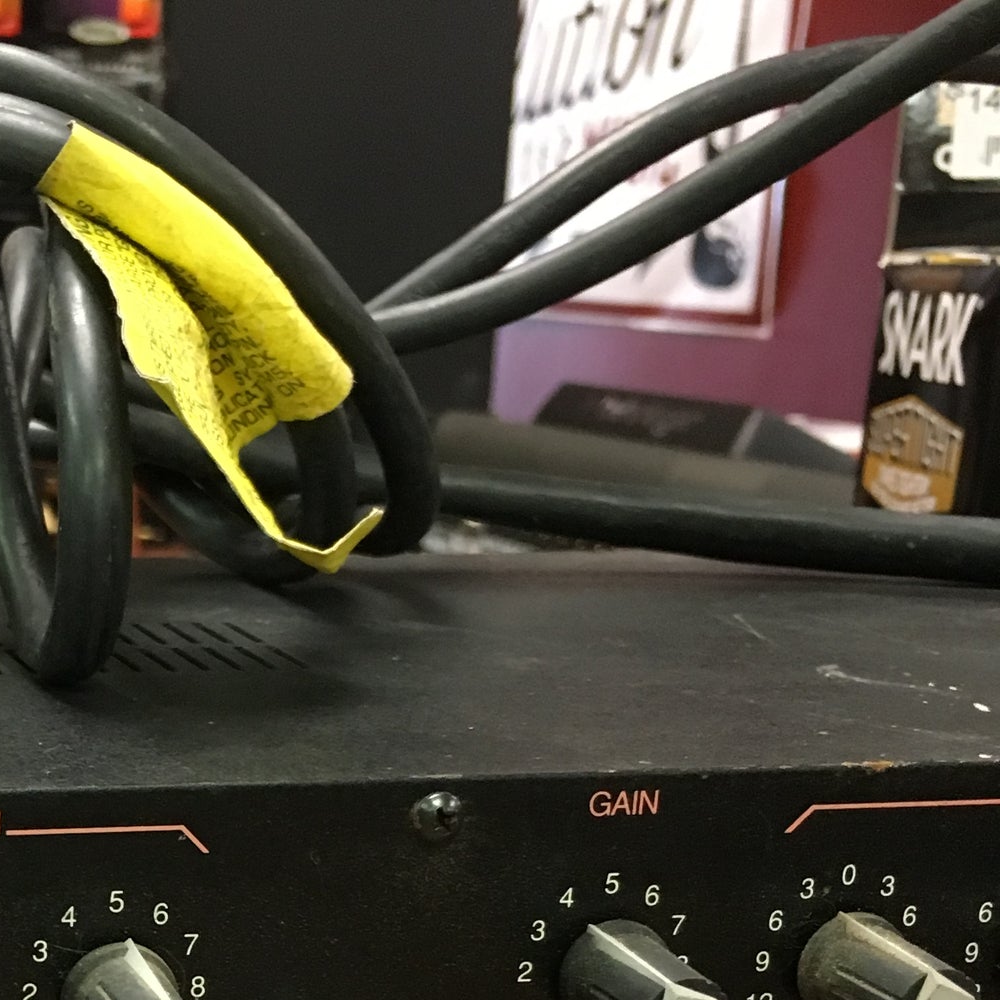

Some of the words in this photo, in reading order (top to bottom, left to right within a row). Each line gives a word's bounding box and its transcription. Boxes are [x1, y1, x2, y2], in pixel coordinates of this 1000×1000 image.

[877, 288, 980, 387] SNARK
[589, 789, 660, 817] GAIN
[604, 872, 620, 895] 5
[841, 863, 857, 886] 0
[880, 875, 895, 897] 3
[559, 887, 574, 908] 4
[645, 884, 660, 907] 6
[799, 877, 815, 900] 3
[108, 890, 125, 913] 5
[978, 901, 994, 923] 6
[60, 905, 77, 928] 4
[153, 902, 169, 925] 6
[671, 914, 686, 936] 7
[768, 909, 784, 932] 6
[902, 905, 917, 927] 6
[530, 919, 546, 942] 3
[32, 939, 48, 963] 3
[183, 933, 199, 956] 7
[964, 941, 979, 963] 9
[517, 961, 533, 983] 2
[755, 951, 770, 972] 9
[190, 975, 206, 998] 8
